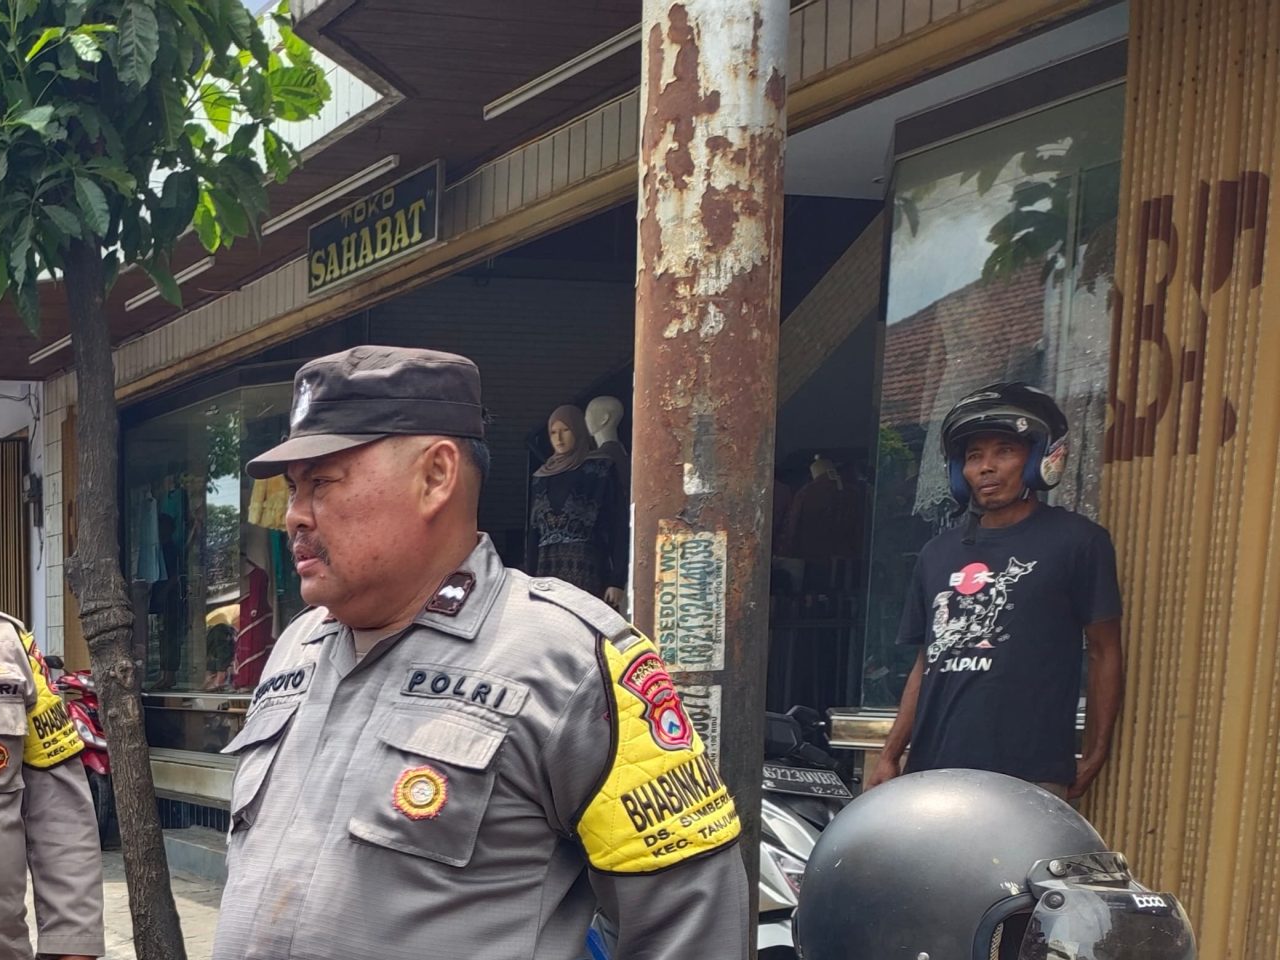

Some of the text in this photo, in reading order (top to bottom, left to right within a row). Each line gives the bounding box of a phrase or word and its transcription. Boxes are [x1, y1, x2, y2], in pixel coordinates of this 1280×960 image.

[340, 188, 394, 229] TOKO
[940, 656, 992, 672] JAPAN
[408, 670, 508, 708] POLRI
[643, 829, 675, 848] DS.
[652, 838, 693, 858] KEC.
